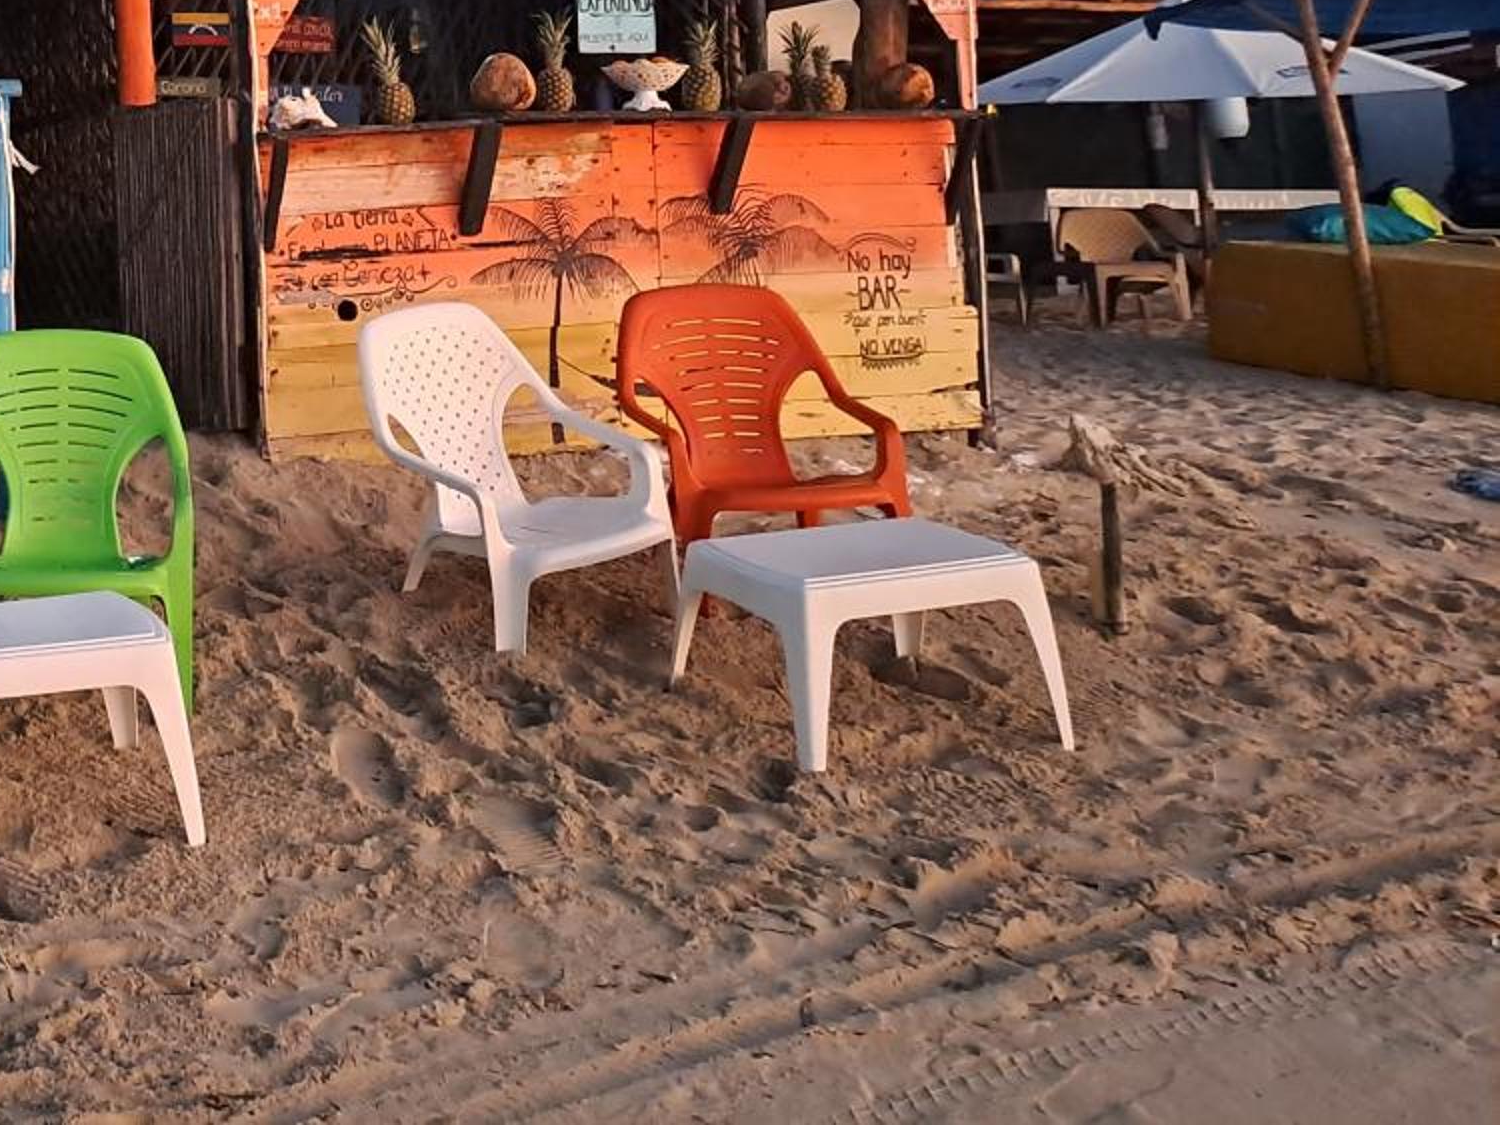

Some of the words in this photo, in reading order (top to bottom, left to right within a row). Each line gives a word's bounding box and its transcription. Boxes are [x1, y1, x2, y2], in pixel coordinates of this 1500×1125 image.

[325, 212, 345, 229] La
[374, 229, 448, 254] PLANETA
[847, 250, 871, 273] No
[879, 246, 911, 280] hay
[857, 274, 903, 311] BAR
[860, 338, 879, 356] NO
